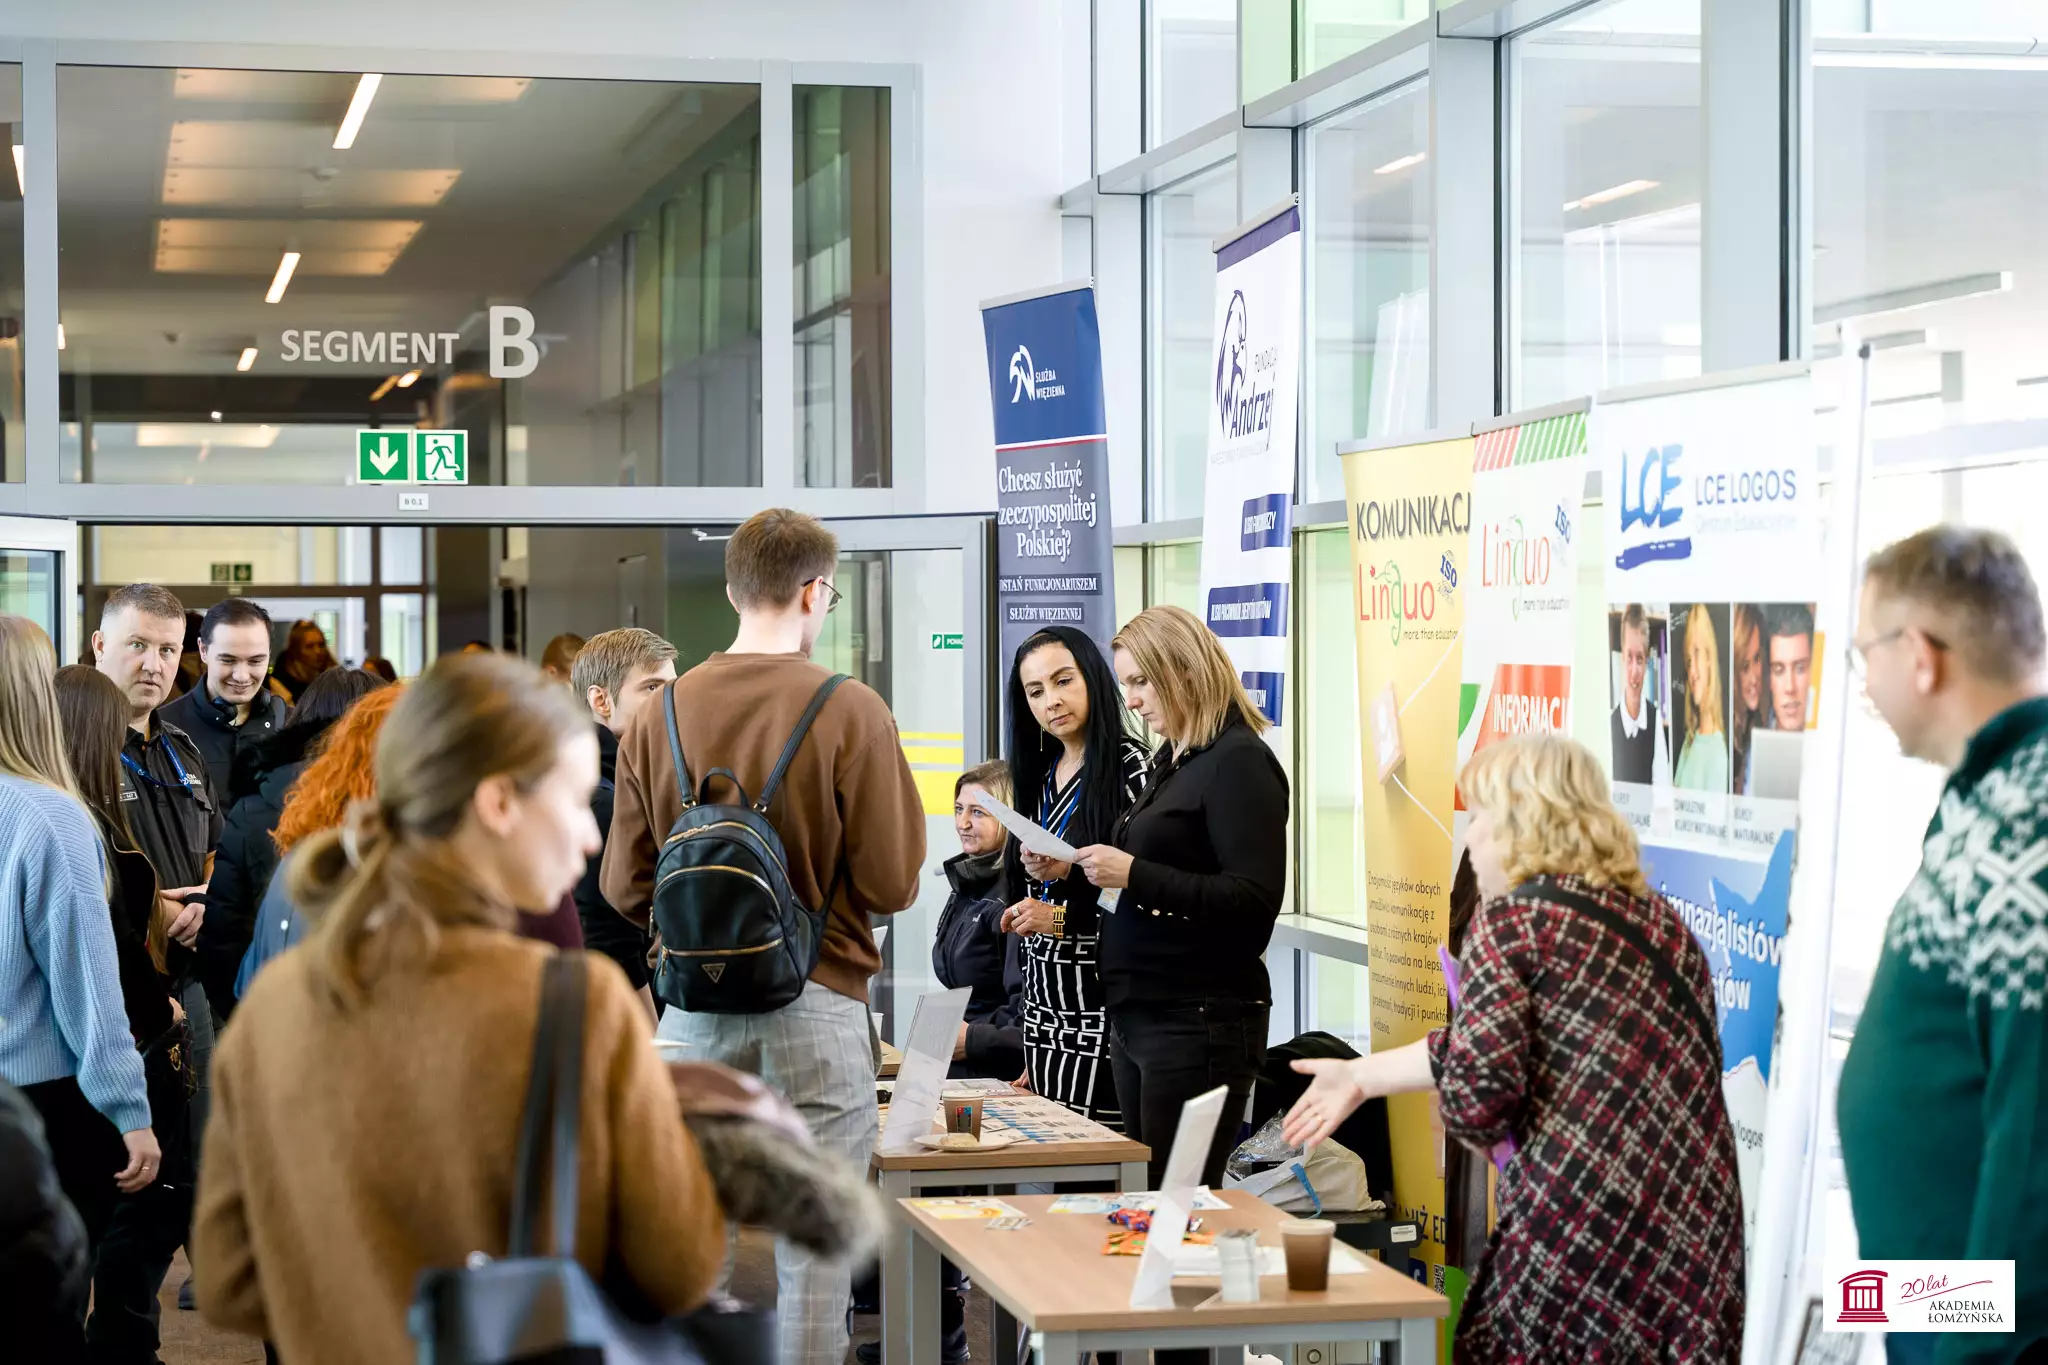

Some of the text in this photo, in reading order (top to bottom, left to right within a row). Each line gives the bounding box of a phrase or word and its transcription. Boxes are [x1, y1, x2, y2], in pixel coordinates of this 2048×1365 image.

[281, 305, 540, 378] SEGMENT B
[1230, 372, 1276, 452] Andrzej
[999, 460, 1083, 495] Chcesz służyć
[1621, 444, 1683, 533] LCE
[1696, 469, 1797, 505] LCE LOGOS
[1016, 530, 1071, 562] Polskiej?
[1440, 555, 1457, 587] ISO
[1482, 515, 1550, 621] Linguo
[1024, 577, 1097, 592] FUNKCJONARIUSZEM
[1010, 605, 1038, 621] SŁUŻBY
[1359, 560, 1435, 646] Linguo
[1415, 879, 1441, 899] obcych
[1430, 910, 1435, 920] z
[1413, 929, 1438, 948] krajów
[1412, 957, 1423, 968] na
[1424, 956, 1443, 974] lepsz
[1416, 979, 1436, 998] ludzi,
